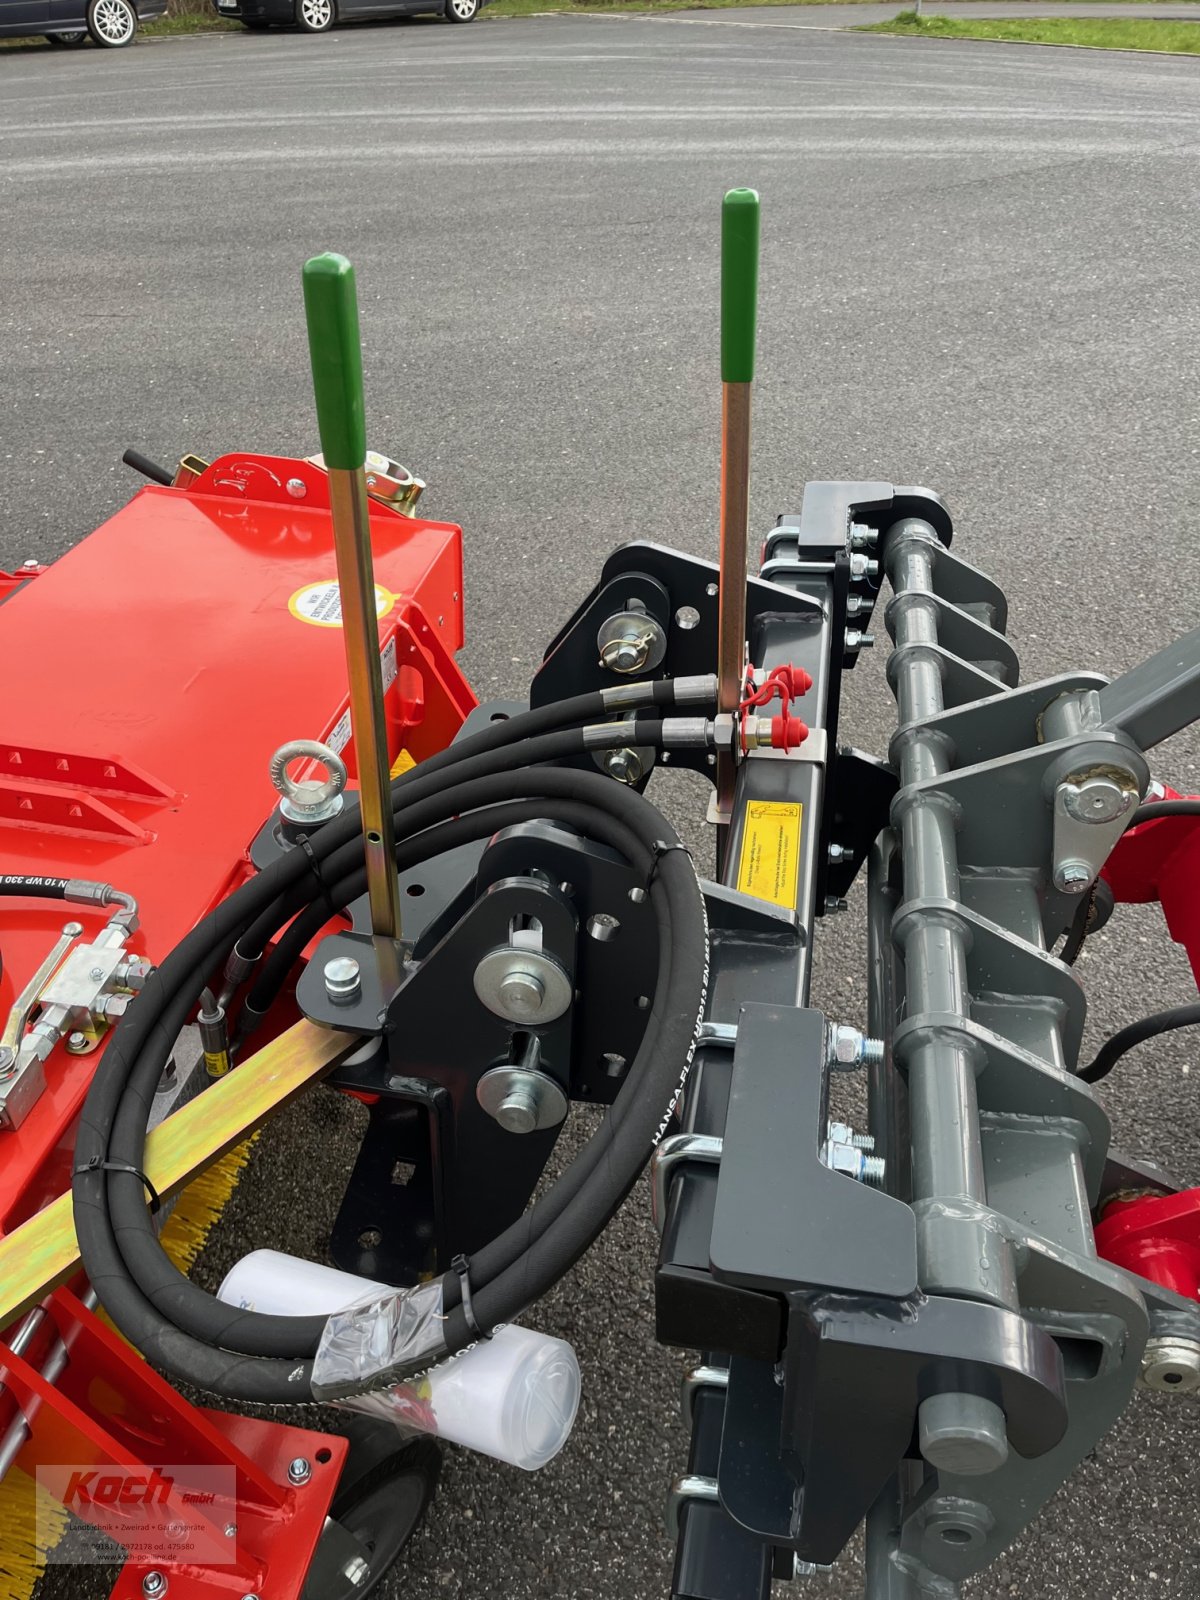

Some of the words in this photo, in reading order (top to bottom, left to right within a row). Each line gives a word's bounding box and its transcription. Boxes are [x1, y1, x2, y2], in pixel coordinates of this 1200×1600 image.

[5, 876, 24, 884] 330
[25, 877, 42, 885] WP
[652, 1039, 697, 1146] HANSA-FLEX
